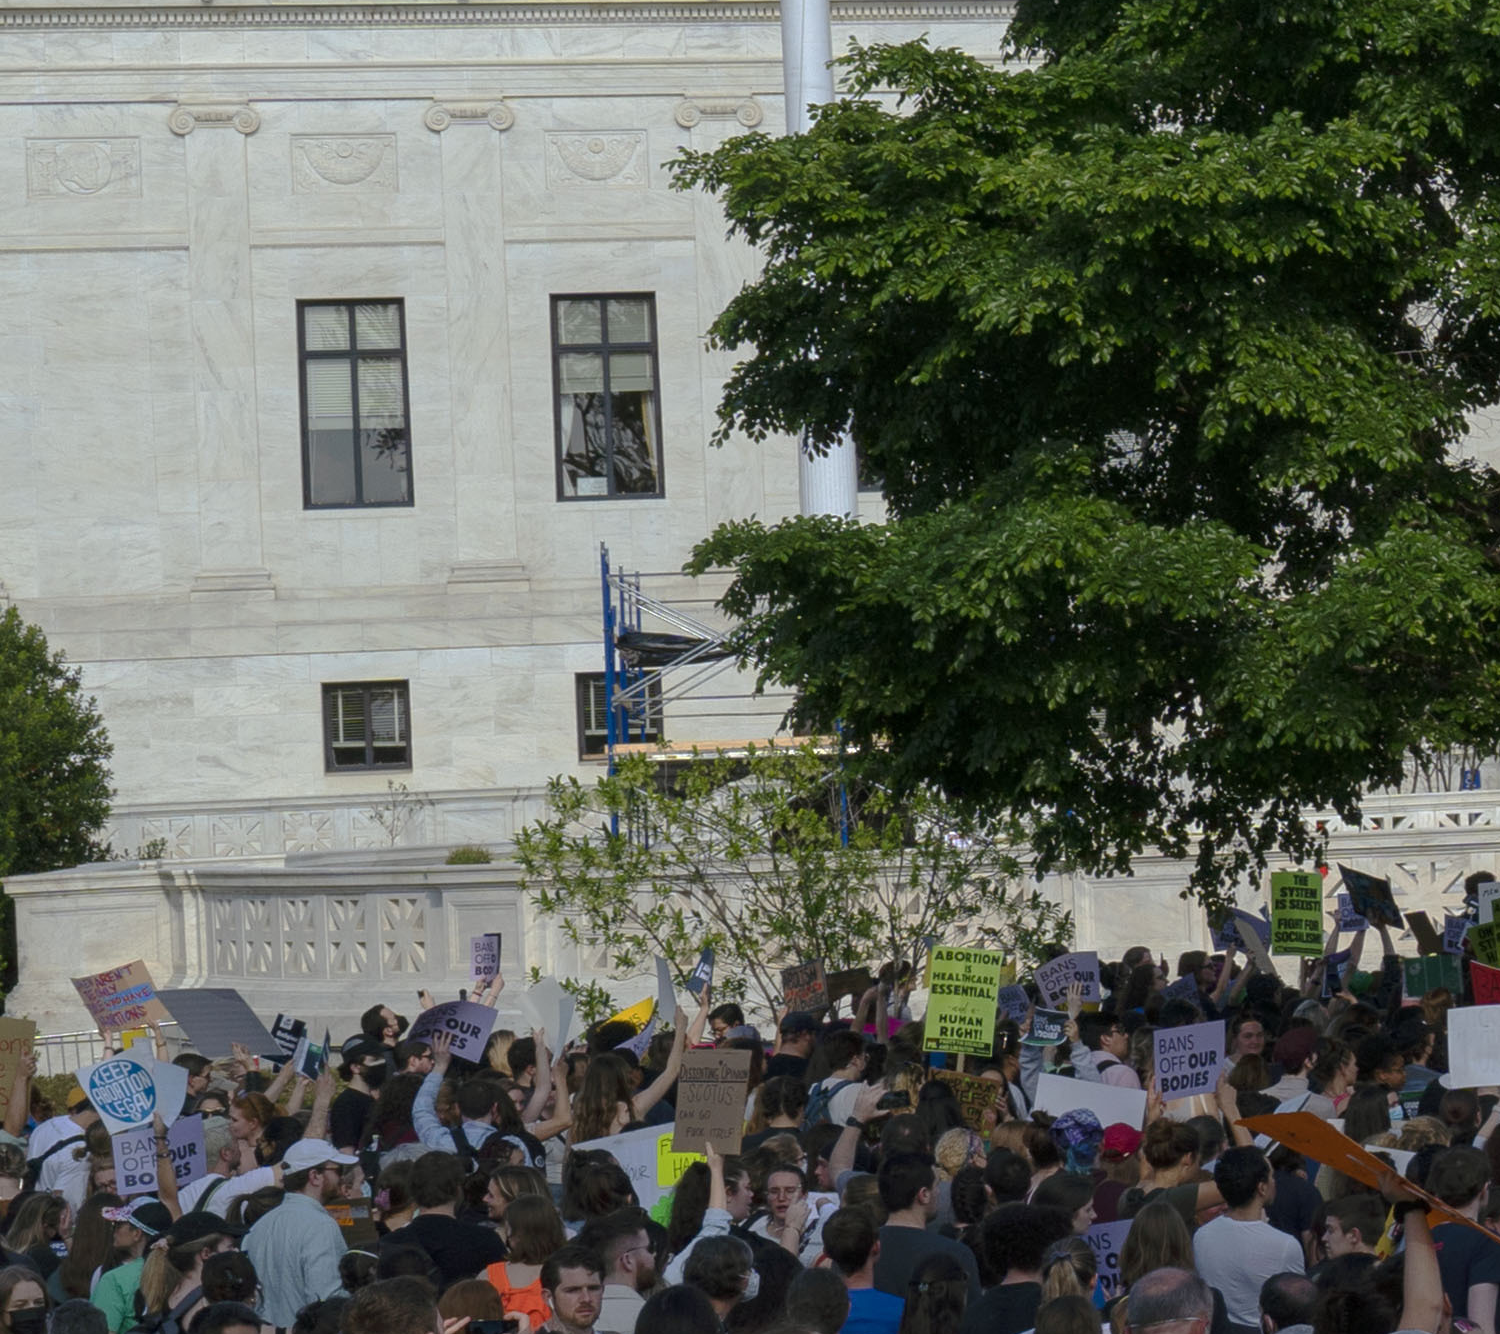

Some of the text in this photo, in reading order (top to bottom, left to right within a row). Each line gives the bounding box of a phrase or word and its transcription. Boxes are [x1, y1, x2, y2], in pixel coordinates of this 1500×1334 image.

[1293, 875, 1309, 886] THE
[1280, 887, 1317, 898] SYSTEM
[1275, 899, 1287, 909] IS
[1277, 919, 1319, 931] FIGHT FOR
[935, 950, 1001, 965] ABORTION
[932, 971, 997, 987] HEALTHCARE,
[1039, 958, 1077, 983] BANS
[1045, 971, 1095, 992] OFF OUR
[931, 984, 995, 1002] ESSENTIAL,
[445, 1018, 482, 1039] OUR
[939, 1014, 983, 1027] HUMAN
[940, 1027, 983, 1039] RIGHT!
[1159, 1035, 1194, 1052] BANS
[1159, 1051, 1217, 1074] OFF OUR
[93, 1061, 132, 1085] KEEP
[1161, 1071, 1209, 1092] BODIES
[91, 1069, 151, 1105] ABORTION
[686, 1084, 735, 1105] SCOTUS
[107, 1092, 154, 1120] LEGAL
